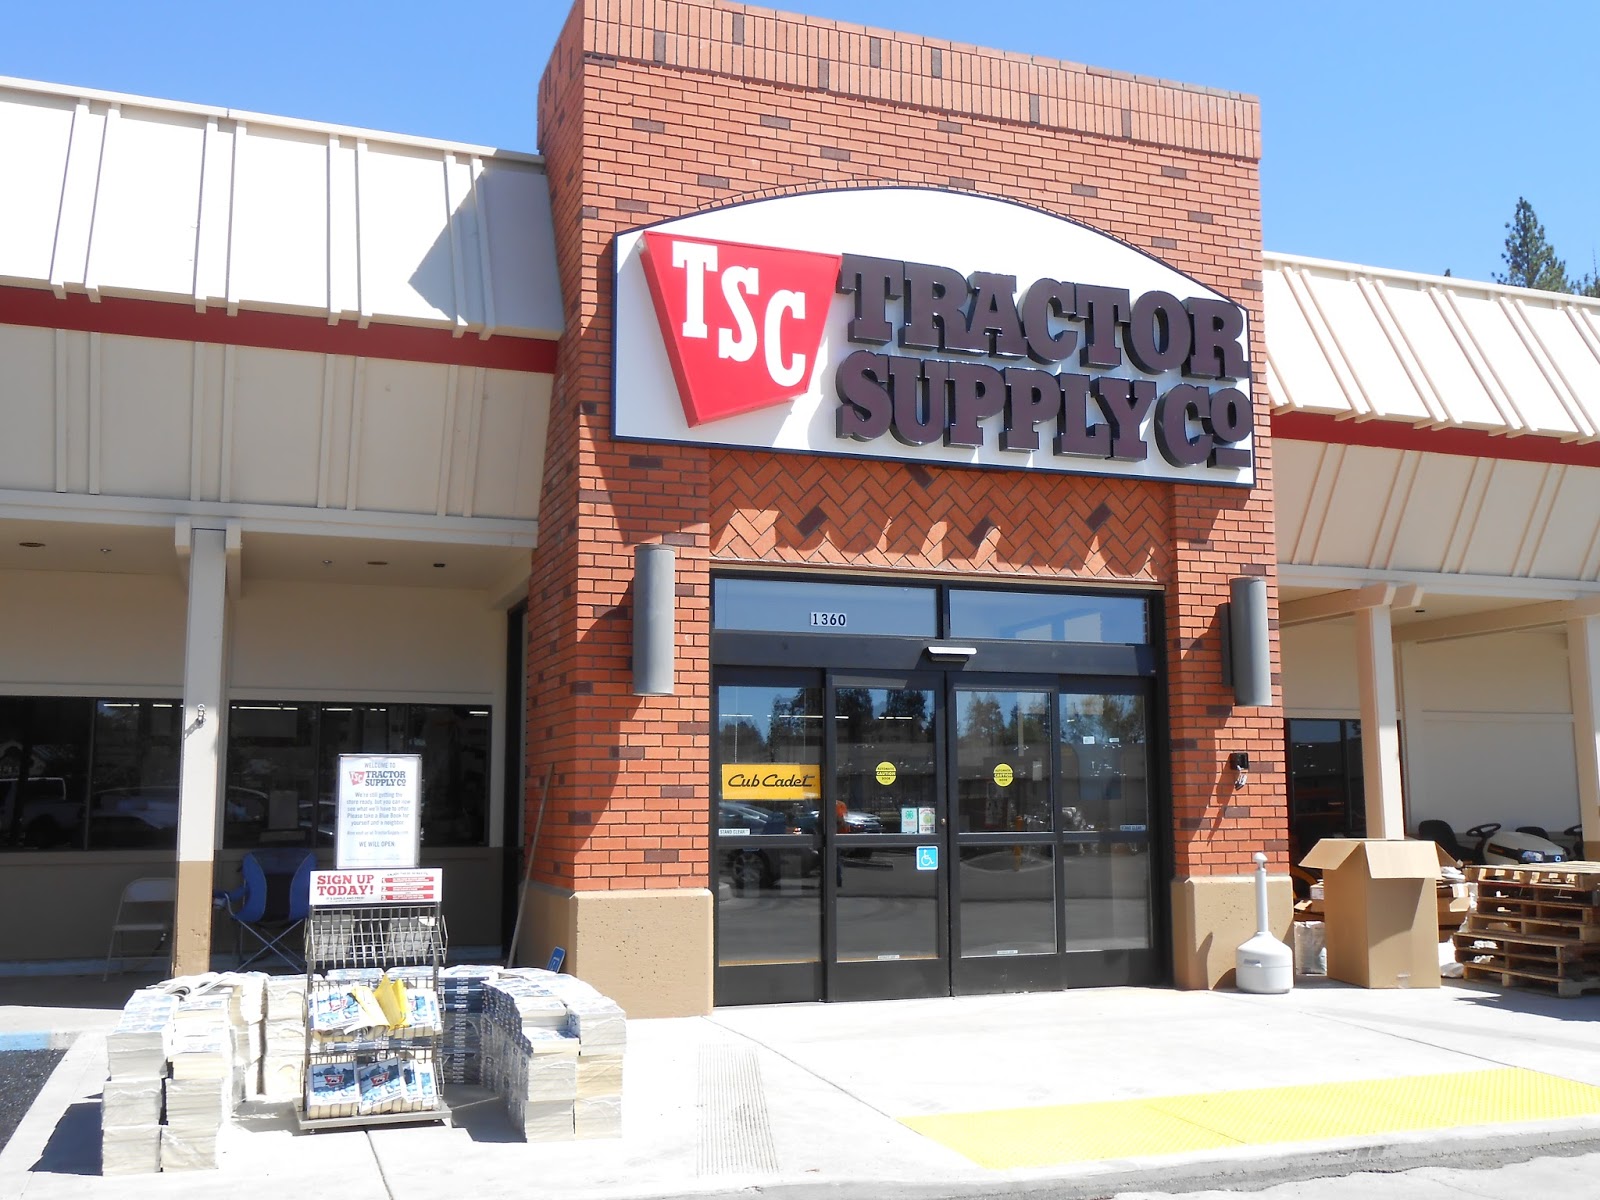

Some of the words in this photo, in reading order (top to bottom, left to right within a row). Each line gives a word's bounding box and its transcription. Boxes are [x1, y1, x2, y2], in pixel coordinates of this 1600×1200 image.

[672, 240, 807, 388] TSC
[836, 254, 1250, 382] TRACTOR
[836, 350, 1157, 462] SUPPLY
[812, 613, 847, 626] 1360
[365, 770, 406, 779] TRACTOR
[727, 773, 760, 788] Cub
[762, 773, 816, 788] Cadet
[365, 779, 396, 787] SUPPLY
[317, 875, 353, 885] SIGN
[357, 874, 375, 884] UP
[317, 885, 374, 896] TODAY!
